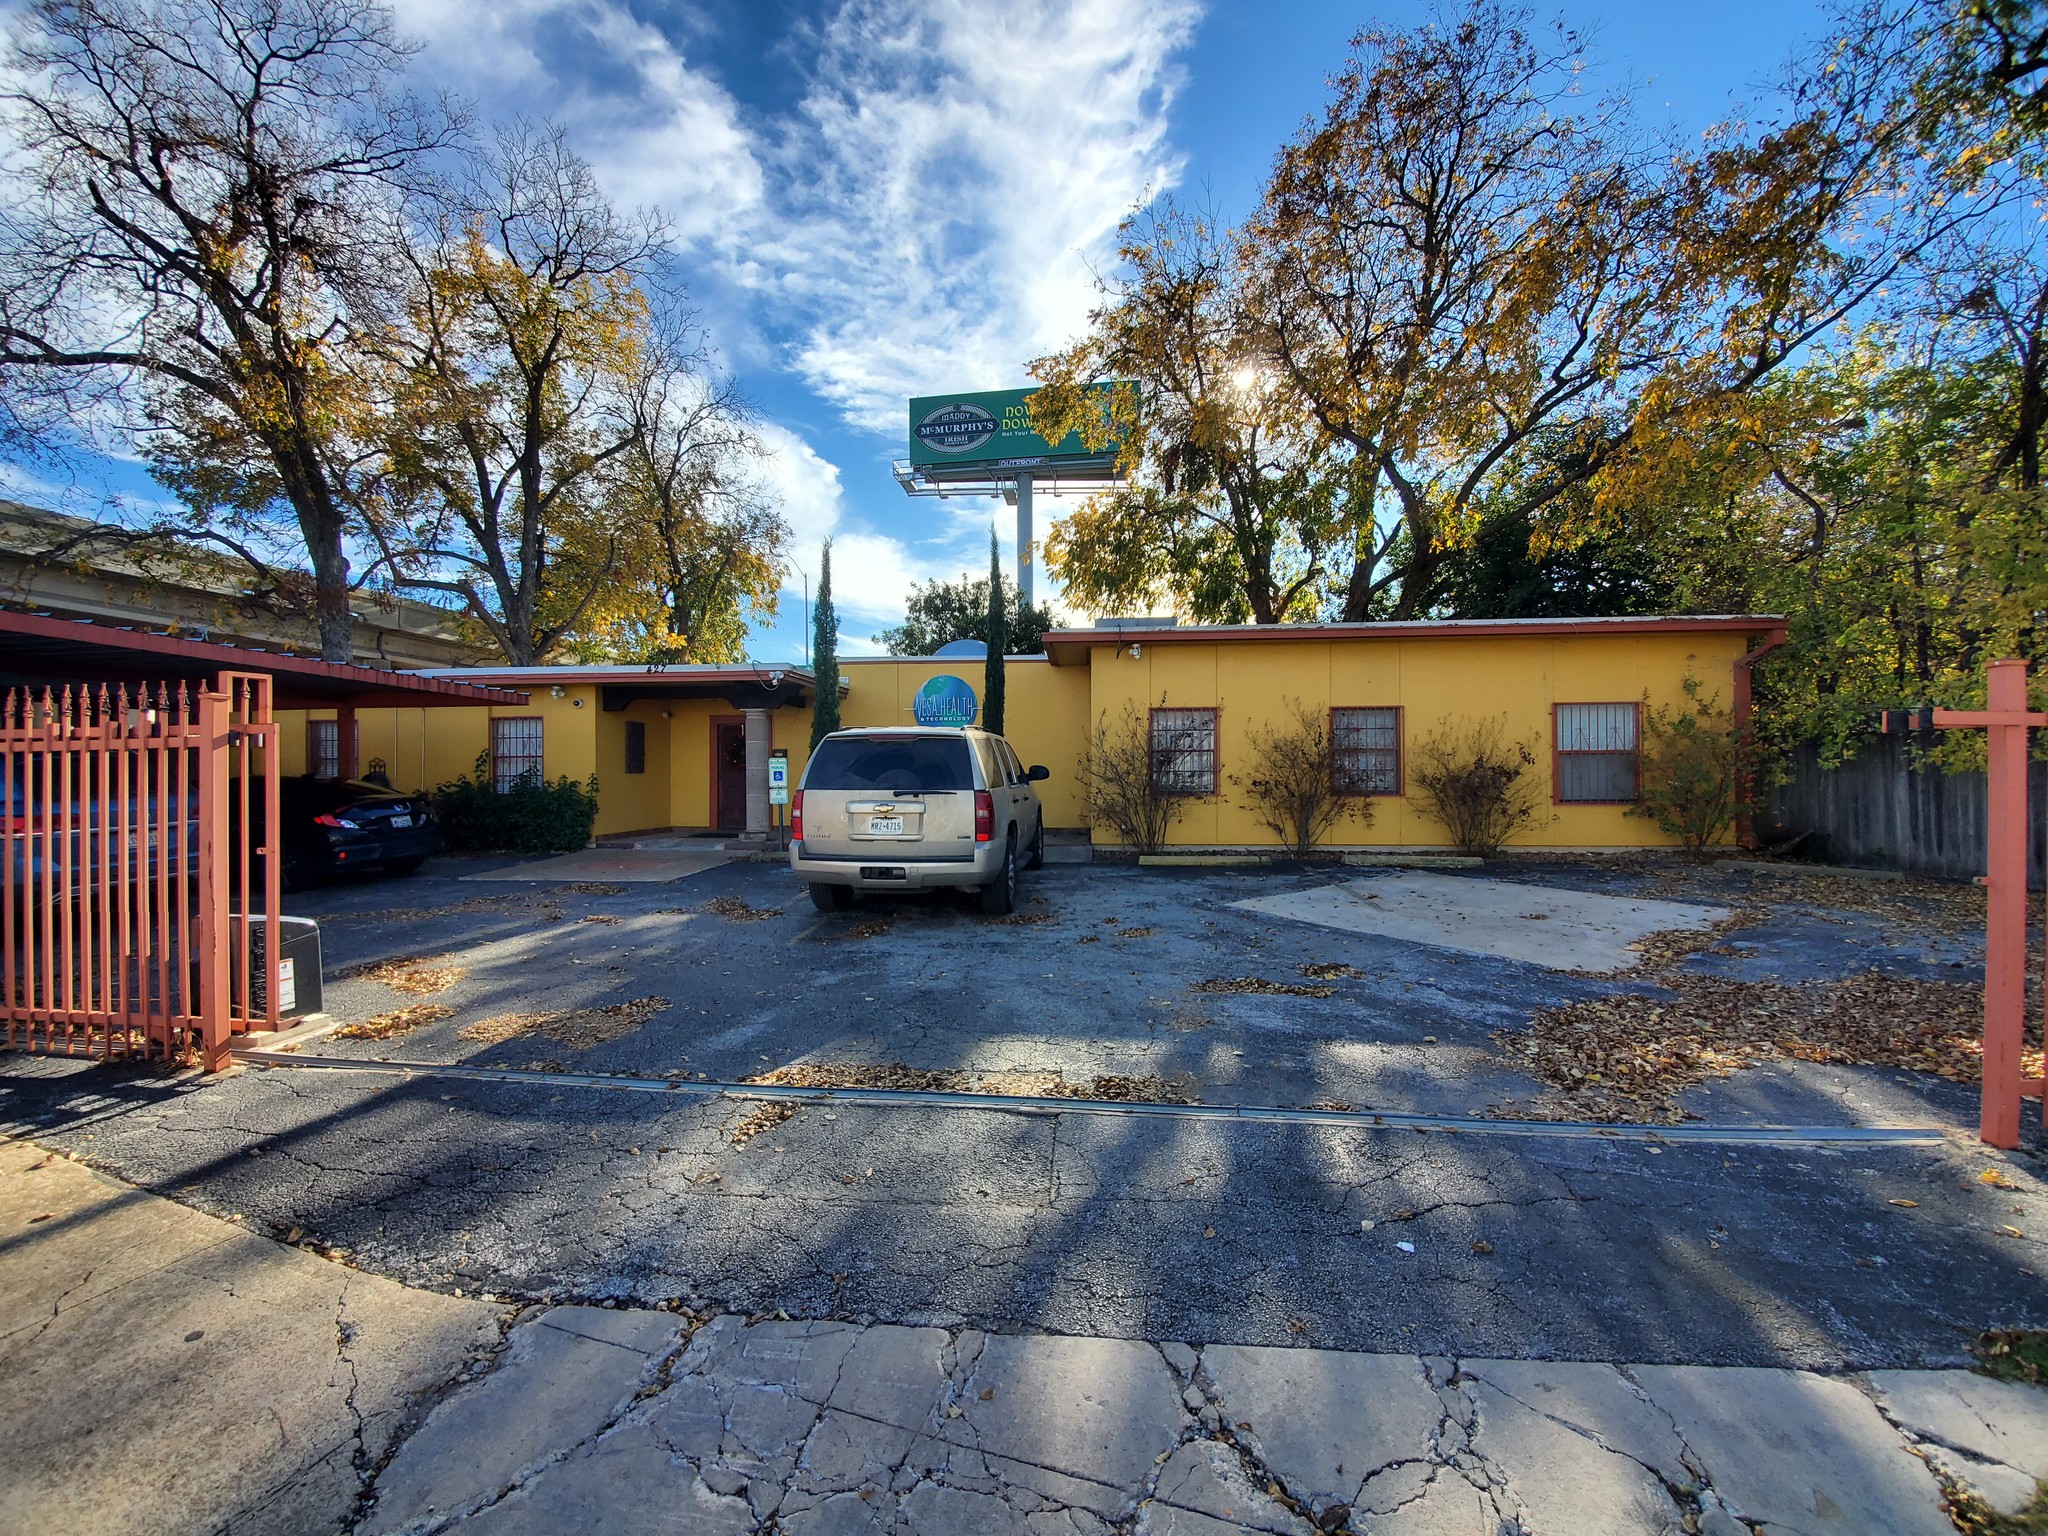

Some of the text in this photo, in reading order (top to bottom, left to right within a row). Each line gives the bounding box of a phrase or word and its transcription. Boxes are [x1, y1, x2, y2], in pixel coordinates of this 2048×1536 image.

[941, 412, 971, 422] MADDY
[920, 421, 994, 436] McMURPHY'S
[1002, 418, 1034, 431] DOW
[944, 435, 968, 443] IRISH
[1000, 458, 1042, 467] OUTFRONT
[646, 663, 668, 674] 427
[940, 693, 973, 718] HEALTH
